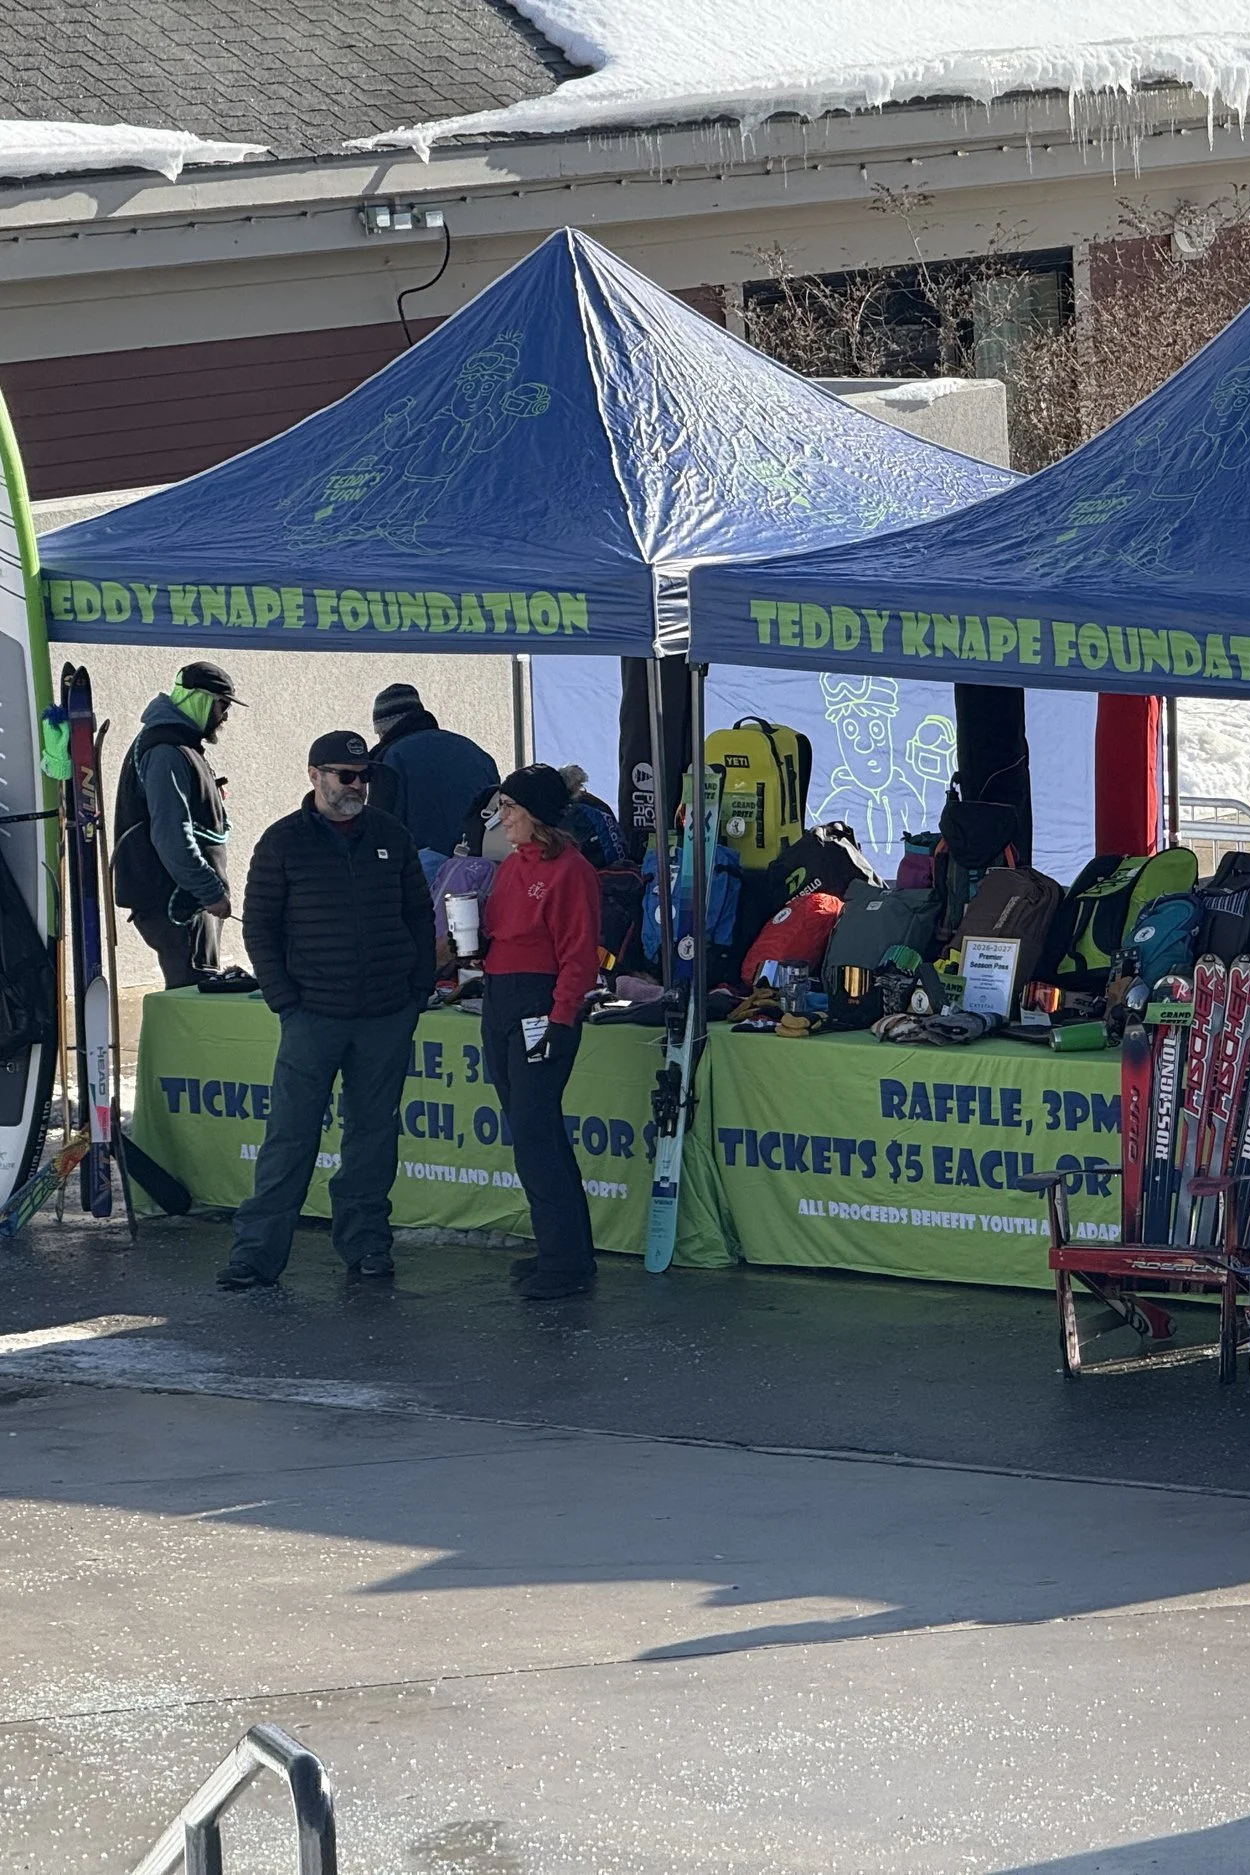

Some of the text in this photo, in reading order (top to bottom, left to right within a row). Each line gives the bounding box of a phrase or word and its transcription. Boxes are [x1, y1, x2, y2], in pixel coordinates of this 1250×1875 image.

[320, 487, 368, 502] TURN
[326, 471, 384, 489] TEDDY'S
[167, 584, 306, 629] KNAPE
[316, 588, 589, 636] FOUNDATION
[750, 599, 893, 654] TEDDY
[899, 610, 1043, 664] KNAPE
[727, 756, 749, 768] YETI
[80, 766, 97, 813] LIN
[731, 801, 756, 809] GRAND
[969, 961, 993, 969] Season
[972, 944, 1012, 952] 2026-2027
[97, 1046, 106, 1096] HEAD
[159, 1076, 274, 1121] TICKE
[879, 1078, 1122, 1136] RAFFLE, 3PM
[1155, 1036, 1177, 1160] ROSSIGNOL
[28, 1123, 48, 1181] OUR-LITE
[717, 1127, 878, 1179] TICKETS
[886, 1139, 924, 1185] $5
[404, 1161, 457, 1182] YOUTH
[458, 1168, 489, 1185] AND
[798, 1198, 826, 1217] ALL
[828, 1202, 909, 1225] PROCEEDS
[911, 1208, 977, 1231] BENEFIT
[979, 1215, 1037, 1235] YOUTH
[1130, 1259, 1228, 1275] ROSSIGN
